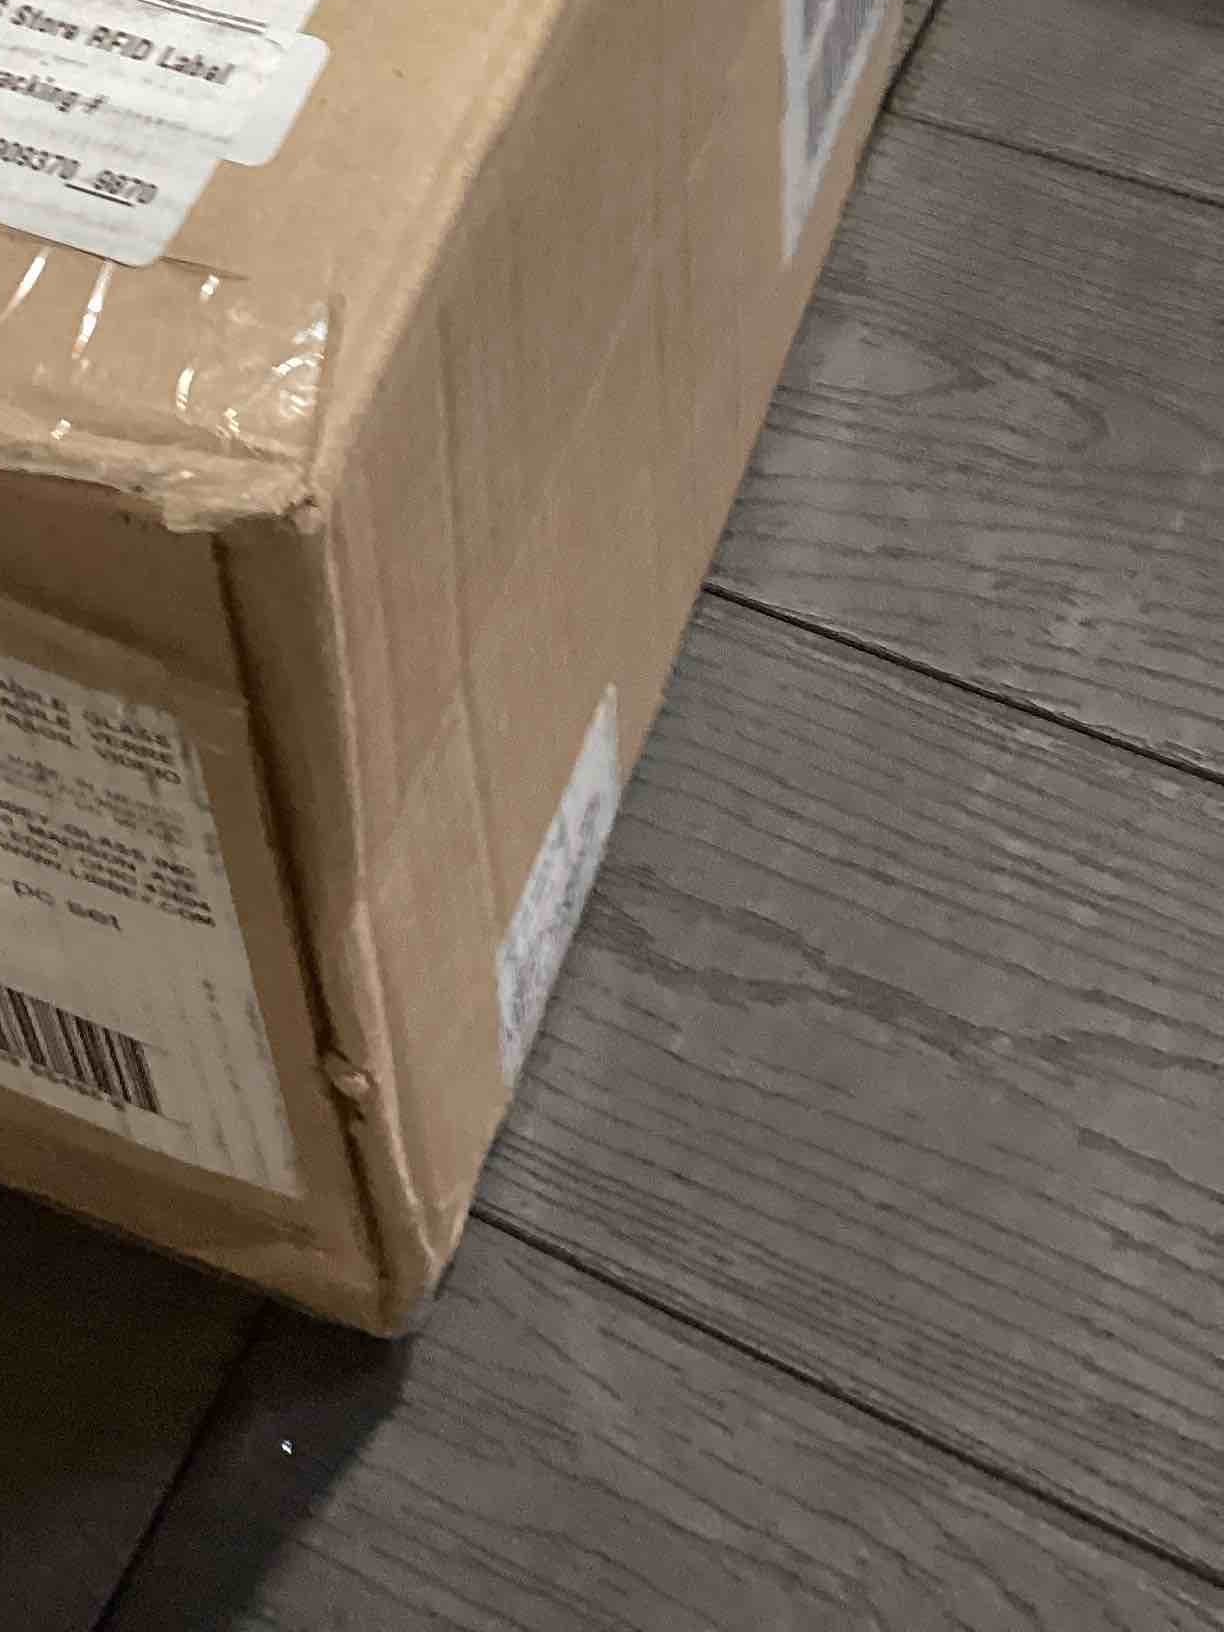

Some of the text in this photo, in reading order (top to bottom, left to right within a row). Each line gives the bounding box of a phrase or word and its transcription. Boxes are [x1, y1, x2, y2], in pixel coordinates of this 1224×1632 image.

[10, 4, 80, 41] Store
[84, 25, 154, 61] RFID
[156, 45, 237, 86] Label
[66, 900, 123, 932] set
